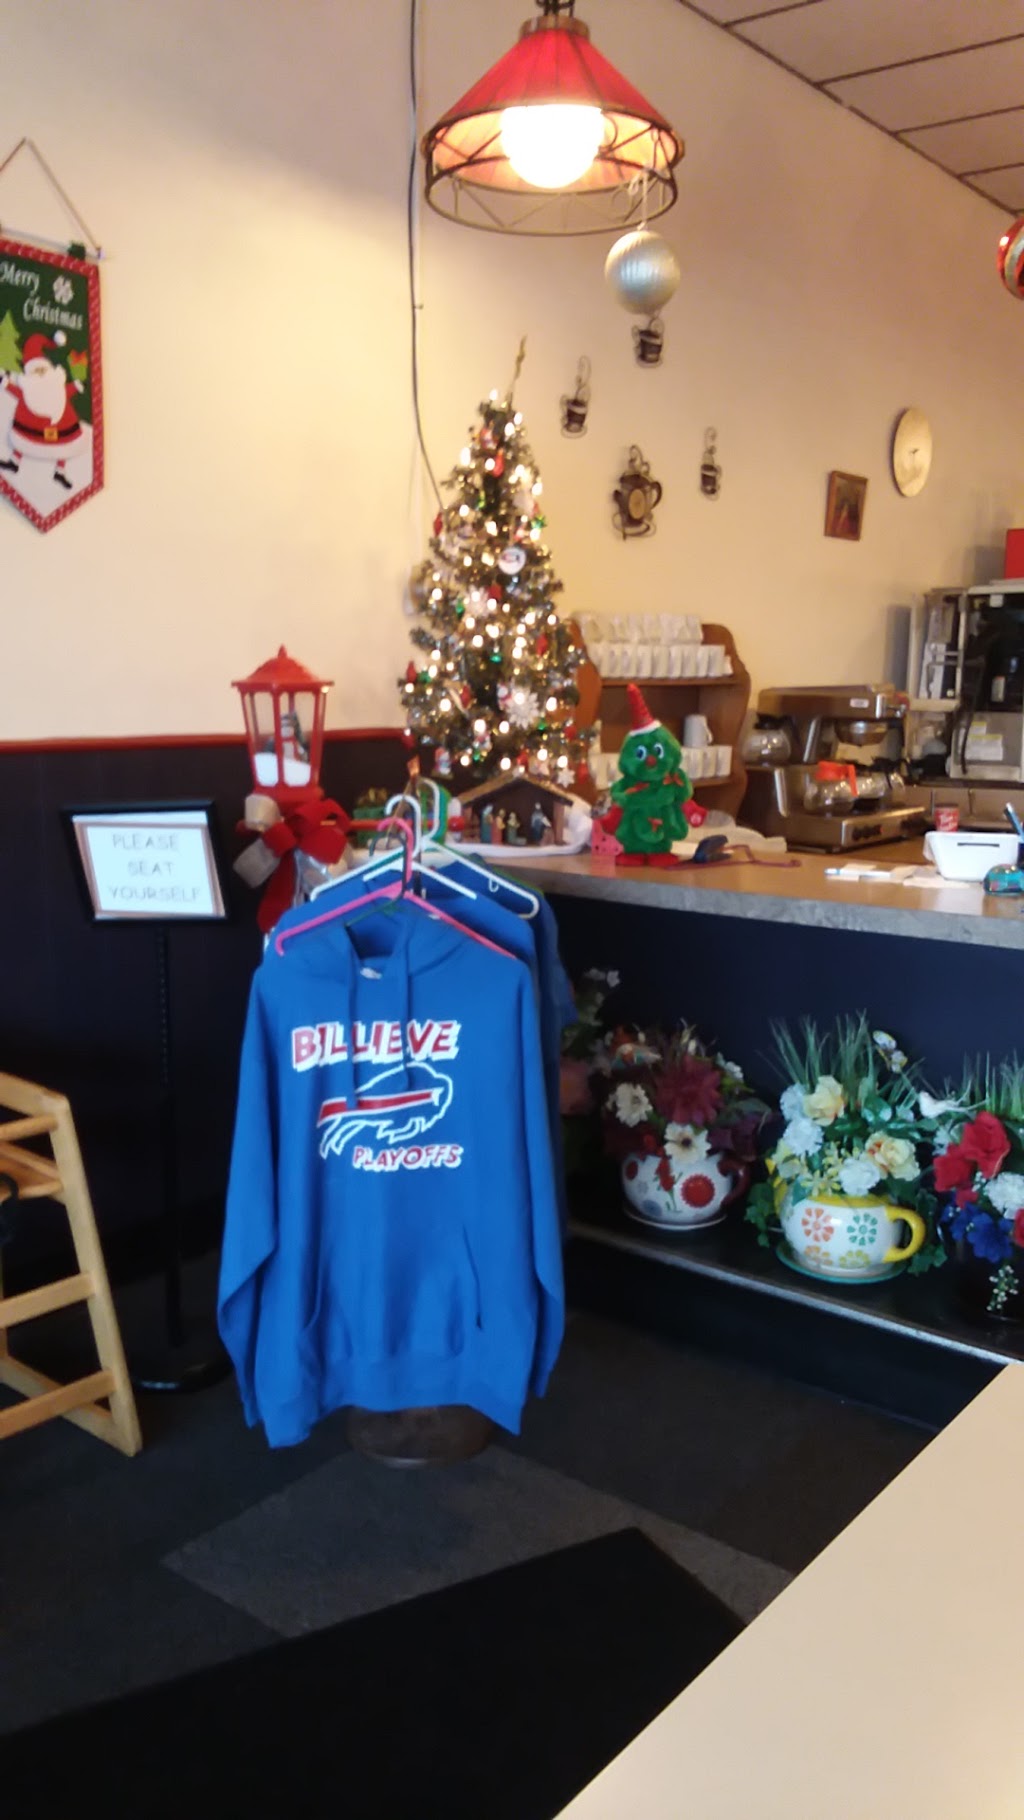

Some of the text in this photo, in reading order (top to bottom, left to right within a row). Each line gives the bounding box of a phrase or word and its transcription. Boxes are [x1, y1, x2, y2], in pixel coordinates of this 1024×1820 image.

[0, 261, 40, 297] Merry
[23, 296, 83, 330] Christmas
[112, 833, 180, 850] PLEASE
[127, 860, 174, 877] SEAT
[108, 885, 201, 902] YOURSELF
[291, 1019, 462, 1072] BILLIEVE
[352, 1143, 464, 1172] PLAYOFFS
